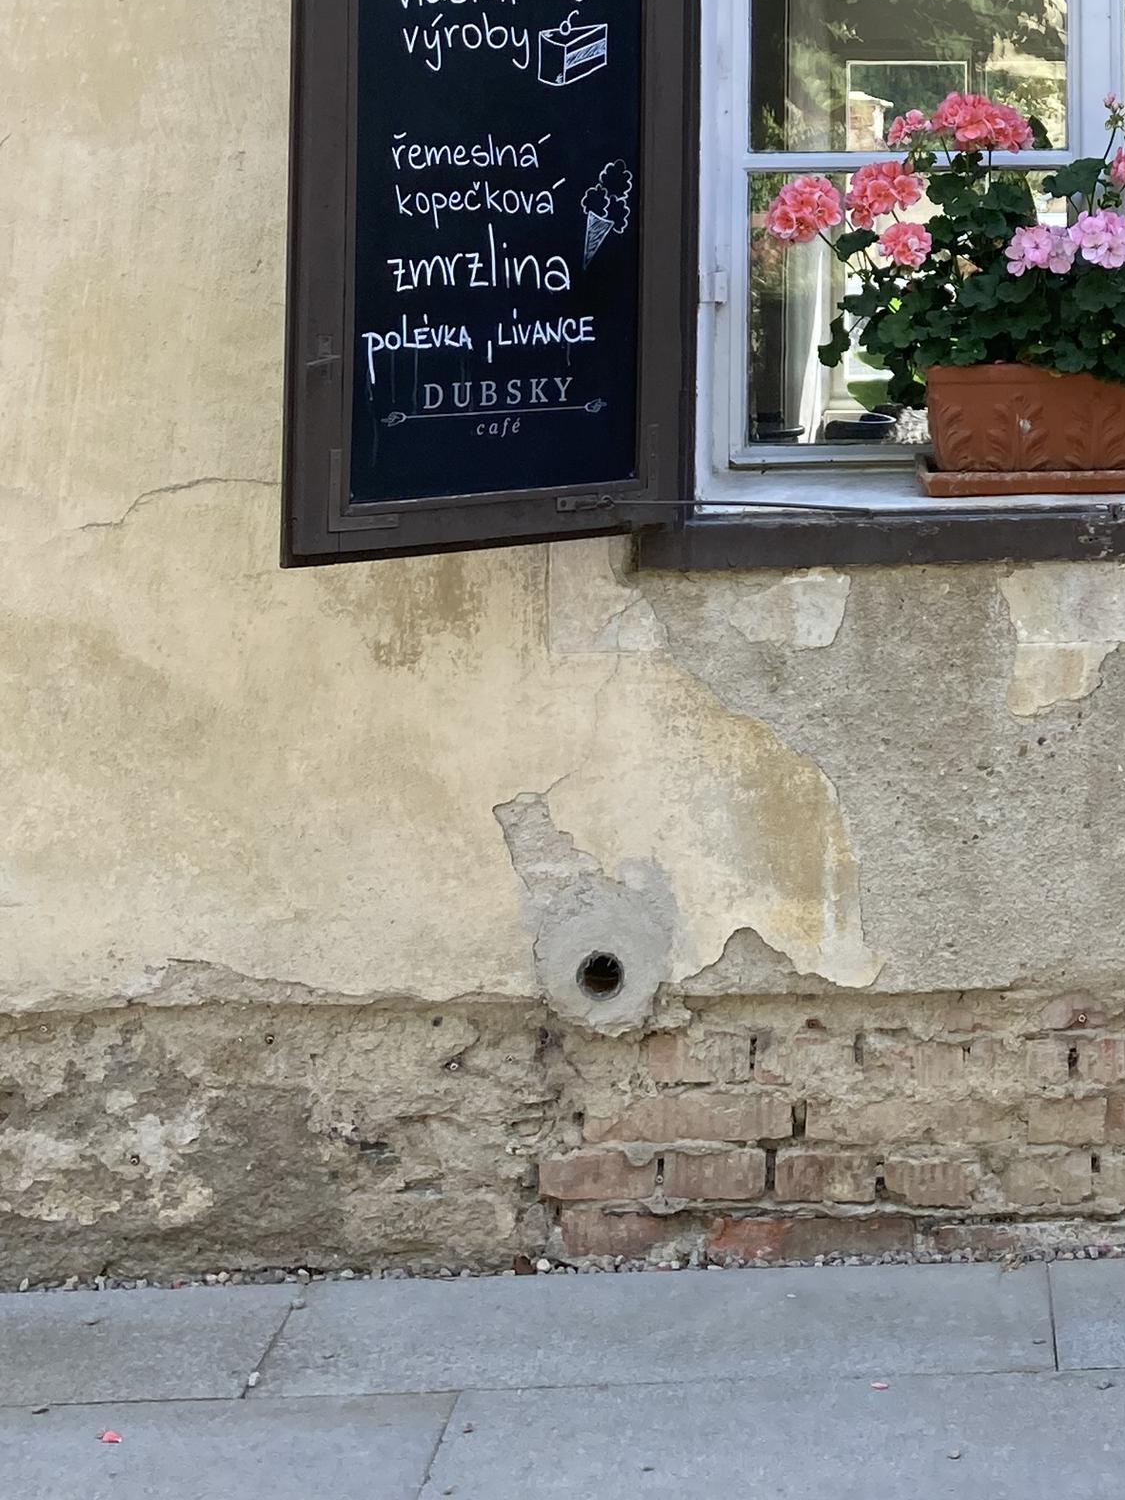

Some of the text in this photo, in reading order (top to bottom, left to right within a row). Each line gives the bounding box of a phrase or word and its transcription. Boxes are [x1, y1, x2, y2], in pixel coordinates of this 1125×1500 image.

[403, 12, 530, 71] výroby
[391, 132, 551, 170] řemeslná
[395, 177, 566, 229] kopečková
[387, 222, 571, 292] zmrzlina
[423, 376, 575, 410] DUBSKY
[476, 417, 521, 437] café
